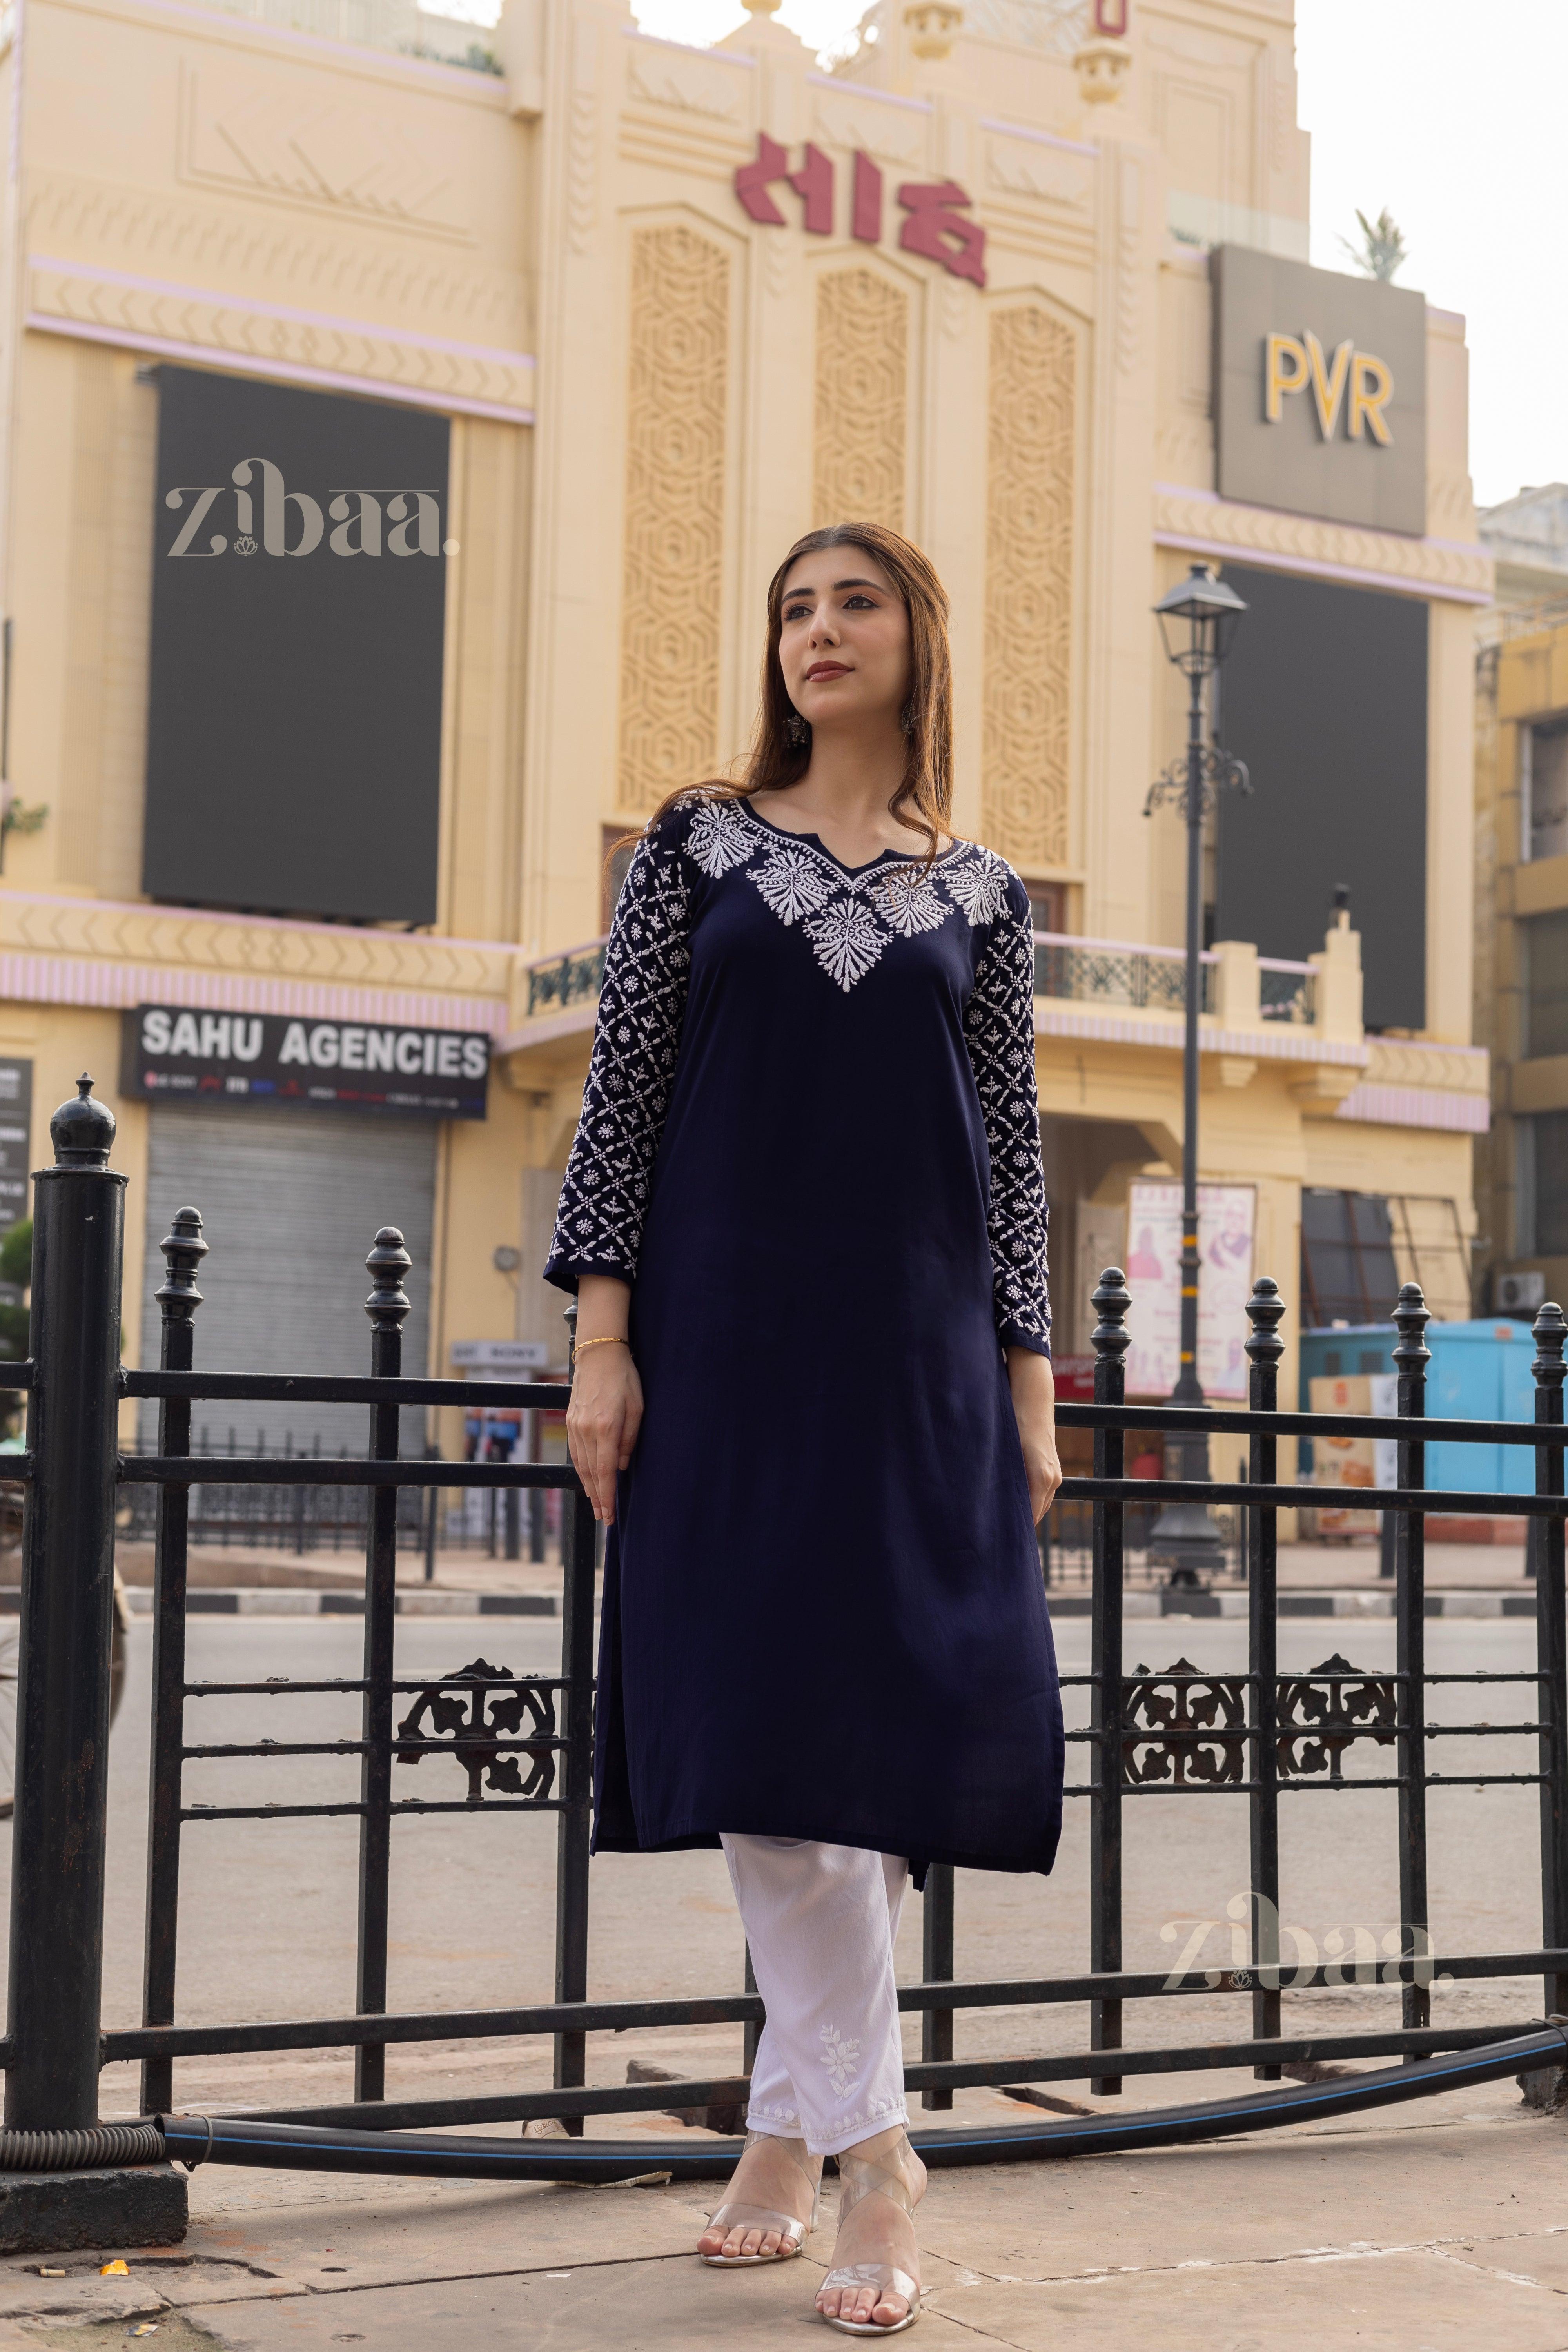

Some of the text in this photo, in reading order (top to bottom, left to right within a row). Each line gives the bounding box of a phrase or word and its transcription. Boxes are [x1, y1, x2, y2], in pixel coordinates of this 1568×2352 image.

[1266, 328, 1394, 446] PVR
[142, 1010, 487, 1079] SAHU AGENCIES
